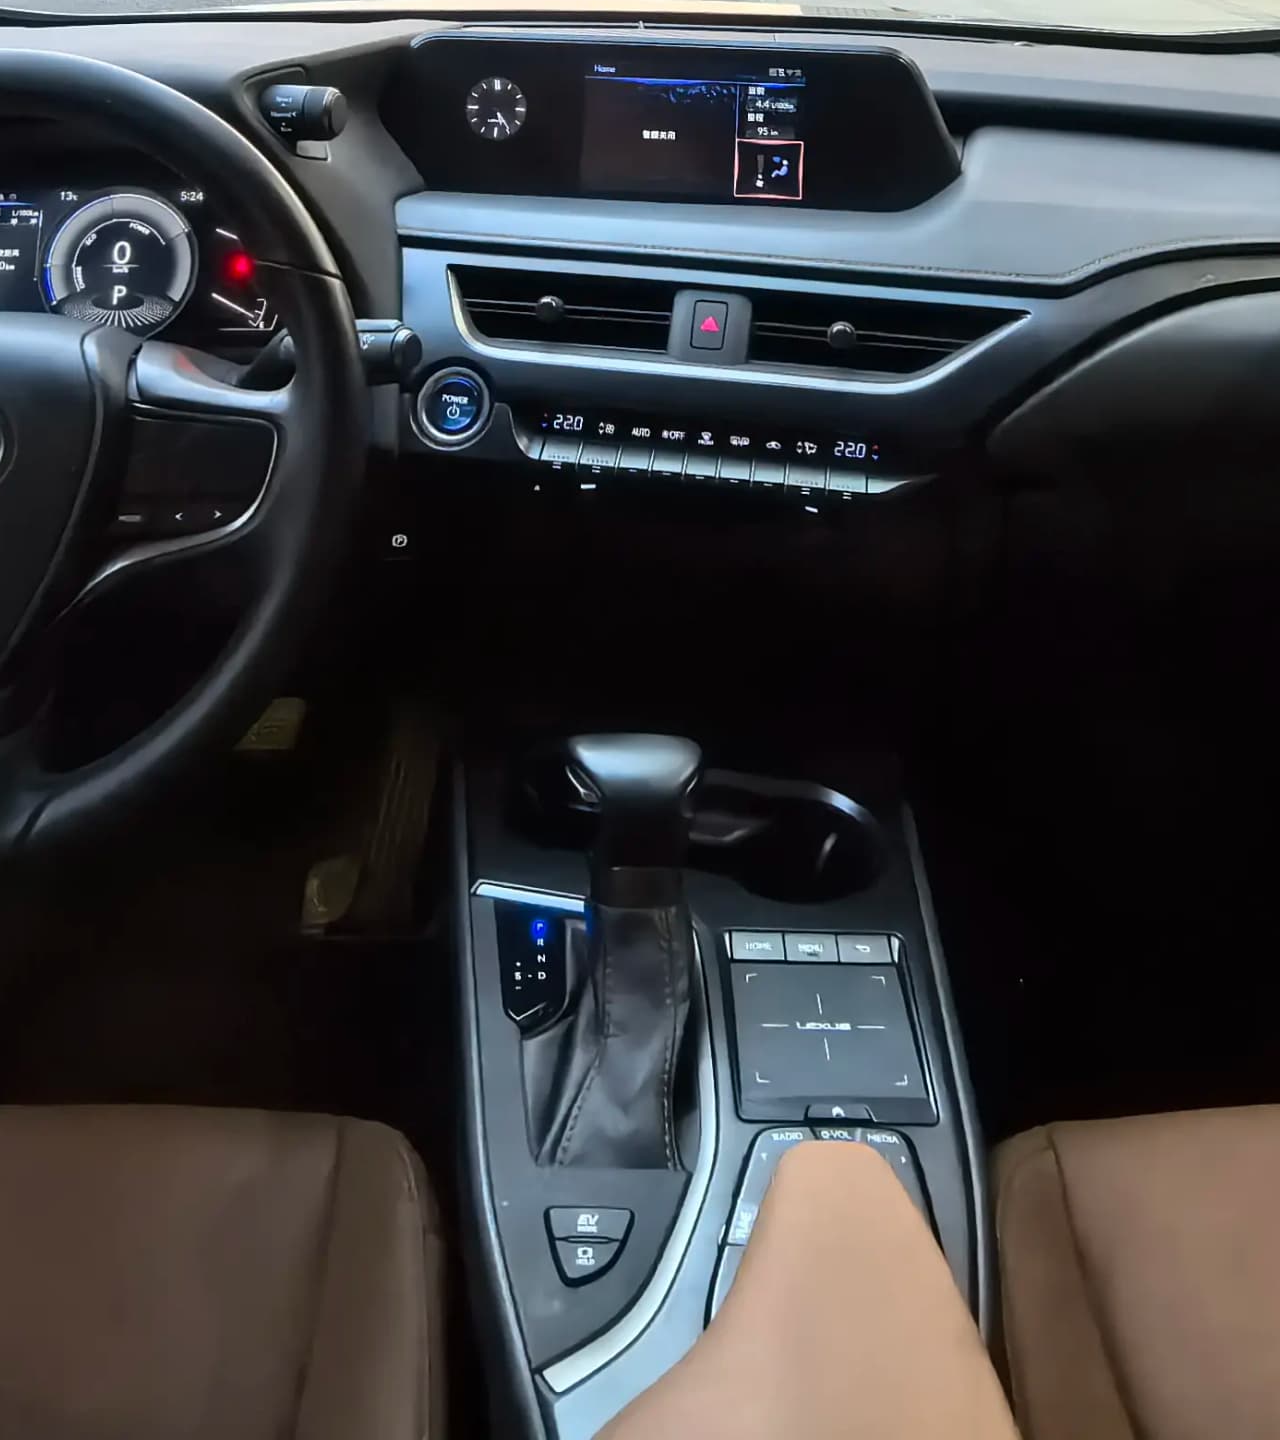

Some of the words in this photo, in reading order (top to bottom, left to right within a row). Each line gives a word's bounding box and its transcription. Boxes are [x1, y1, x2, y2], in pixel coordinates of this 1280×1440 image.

[594, 63, 617, 74] Home
[757, 126, 769, 136] 95
[180, 191, 204, 202] 5:24
[113, 241, 132, 265] 0
[111, 285, 127, 306] P
[441, 393, 470, 405] POWER
[552, 413, 584, 431] 22.0
[631, 427, 651, 438] AUTO
[833, 441, 867, 459] 22.0
[537, 953, 546, 964] N
[771, 1131, 804, 1142] RADIO
[867, 1133, 900, 1145] MEDIA
